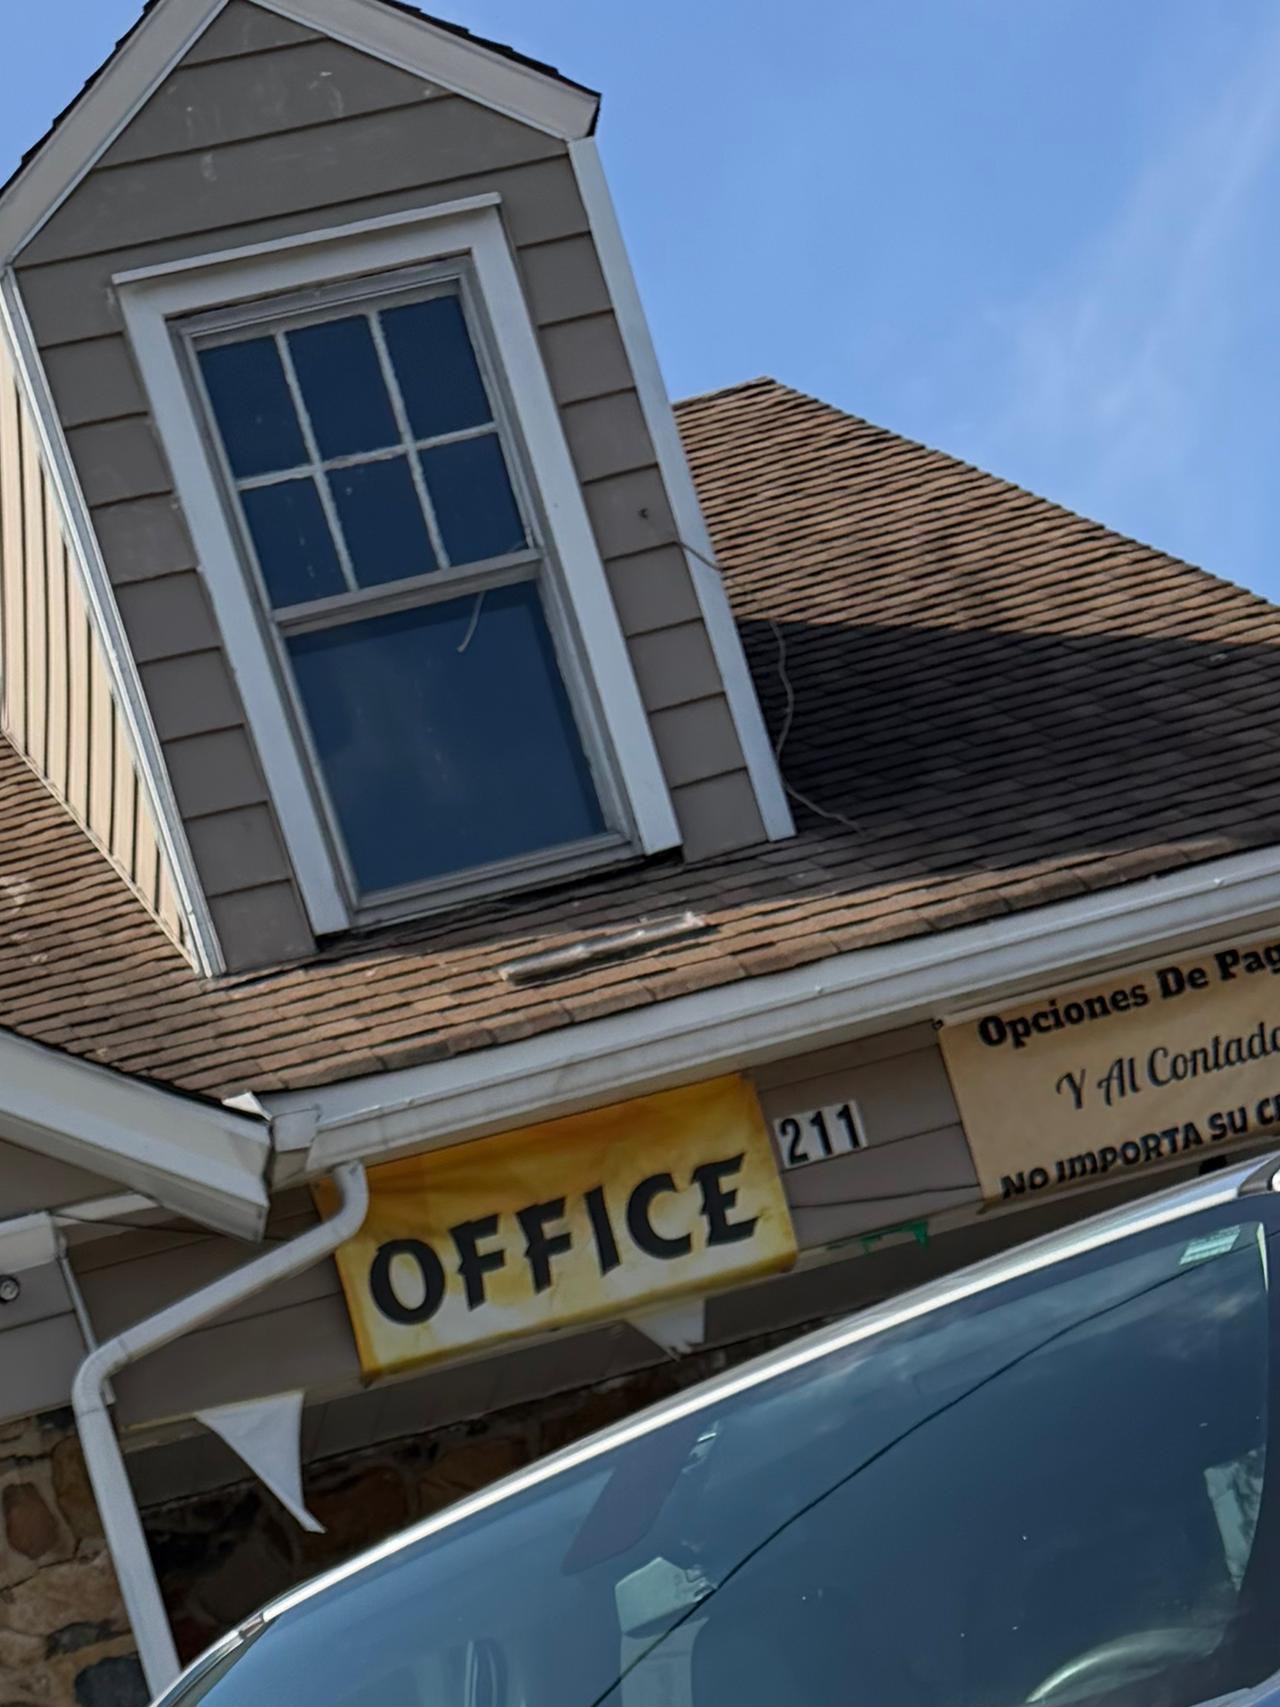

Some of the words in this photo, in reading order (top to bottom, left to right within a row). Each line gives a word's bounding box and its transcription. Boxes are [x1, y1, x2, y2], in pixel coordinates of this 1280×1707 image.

[979, 981, 1148, 1049] Opciones
[1155, 965, 1209, 1000] De
[1056, 1068, 1087, 1110] Y
[1098, 1057, 1141, 1107] Al
[780, 1102, 862, 1166] 211
[1000, 1166, 1049, 1199] NO
[1058, 1123, 1203, 1183] IMPORTA
[1206, 1108, 1246, 1141] SU
[370, 1152, 761, 1326] OFFICE
